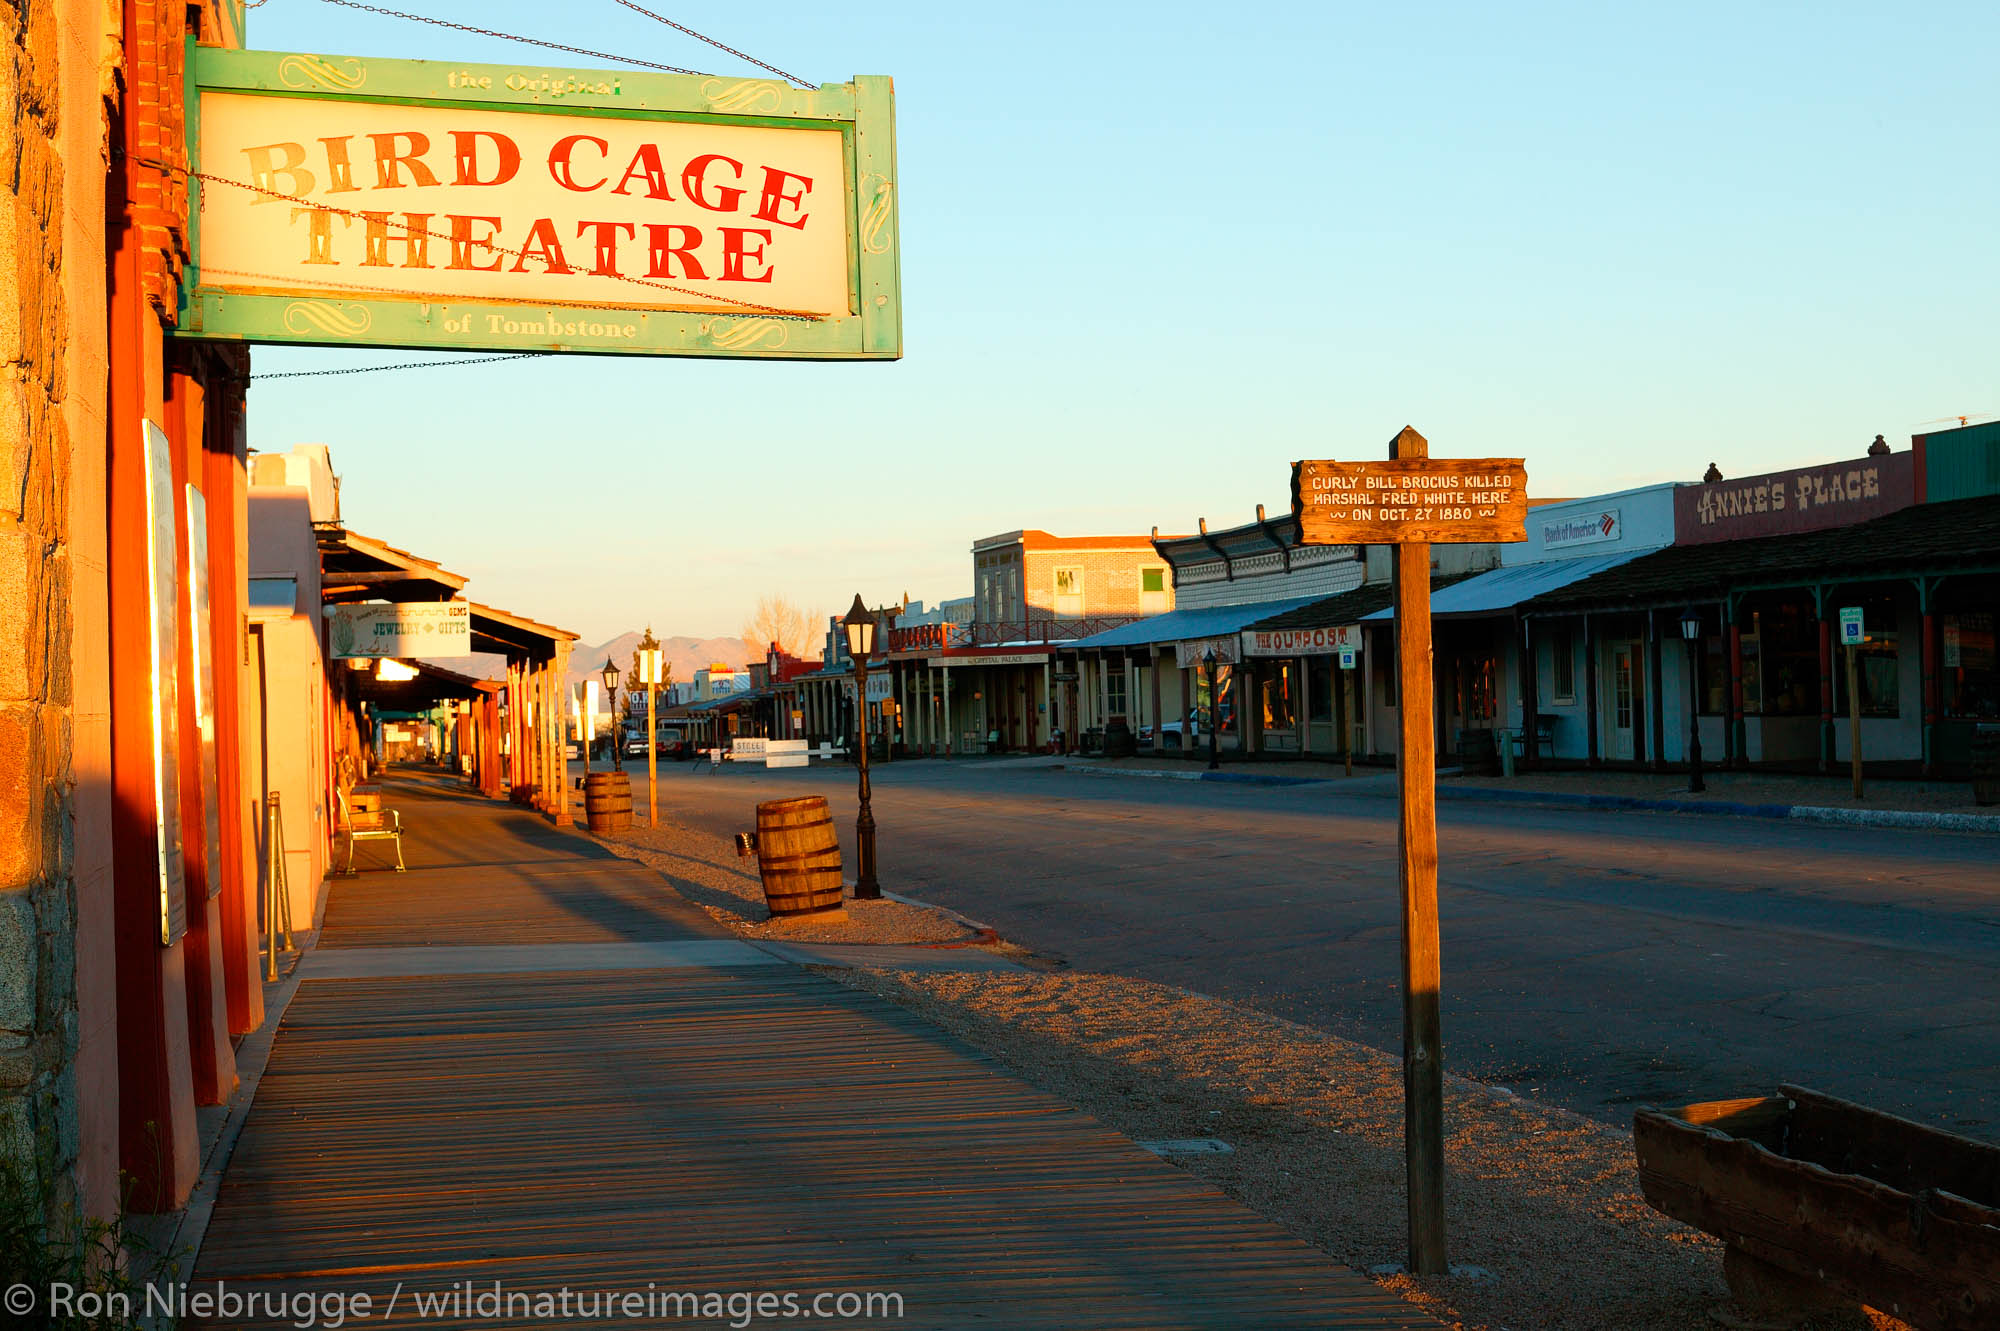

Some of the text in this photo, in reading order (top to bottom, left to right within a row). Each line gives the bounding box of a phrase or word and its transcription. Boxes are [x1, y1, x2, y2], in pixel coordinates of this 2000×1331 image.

[448, 71, 621, 98] the Original
[242, 130, 814, 229] BIRD CAGE
[290, 207, 775, 283] THEATRE
[444, 313, 636, 338] of Tombstone
[1366, 476, 1397, 489] BILL
[1402, 475, 1459, 489] BROCIUS
[1464, 475, 1512, 488] KILLED
[1314, 491, 1511, 505] MARSHAL FRED WHITE HERE
[1697, 467, 1879, 525] ANNIE'S PLACE
[1352, 507, 1473, 521] ON OCT. 27 1880
[1544, 519, 1597, 543] Bank of America
[448, 607, 467, 617] GEMS
[373, 622, 467, 636] JEWELRY GIFTS
[1256, 627, 1348, 649] THE OUTPOST
